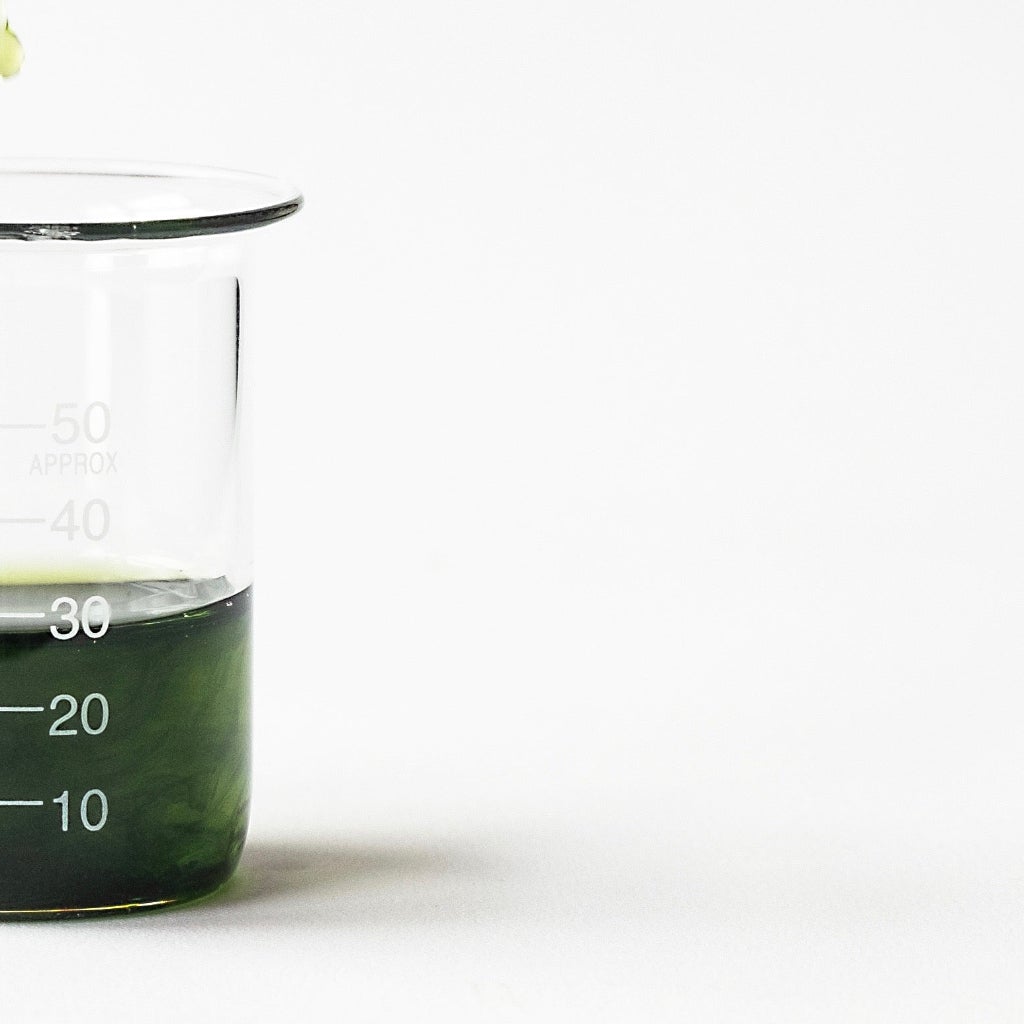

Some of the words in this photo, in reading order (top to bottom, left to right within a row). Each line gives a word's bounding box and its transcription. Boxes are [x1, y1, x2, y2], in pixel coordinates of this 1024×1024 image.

[51, 401, 112, 445] 50
[29, 451, 118, 476] APPROX
[49, 498, 111, 542] 40
[49, 595, 111, 640] 30
[48, 692, 109, 736] 20
[53, 788, 108, 832] 10
